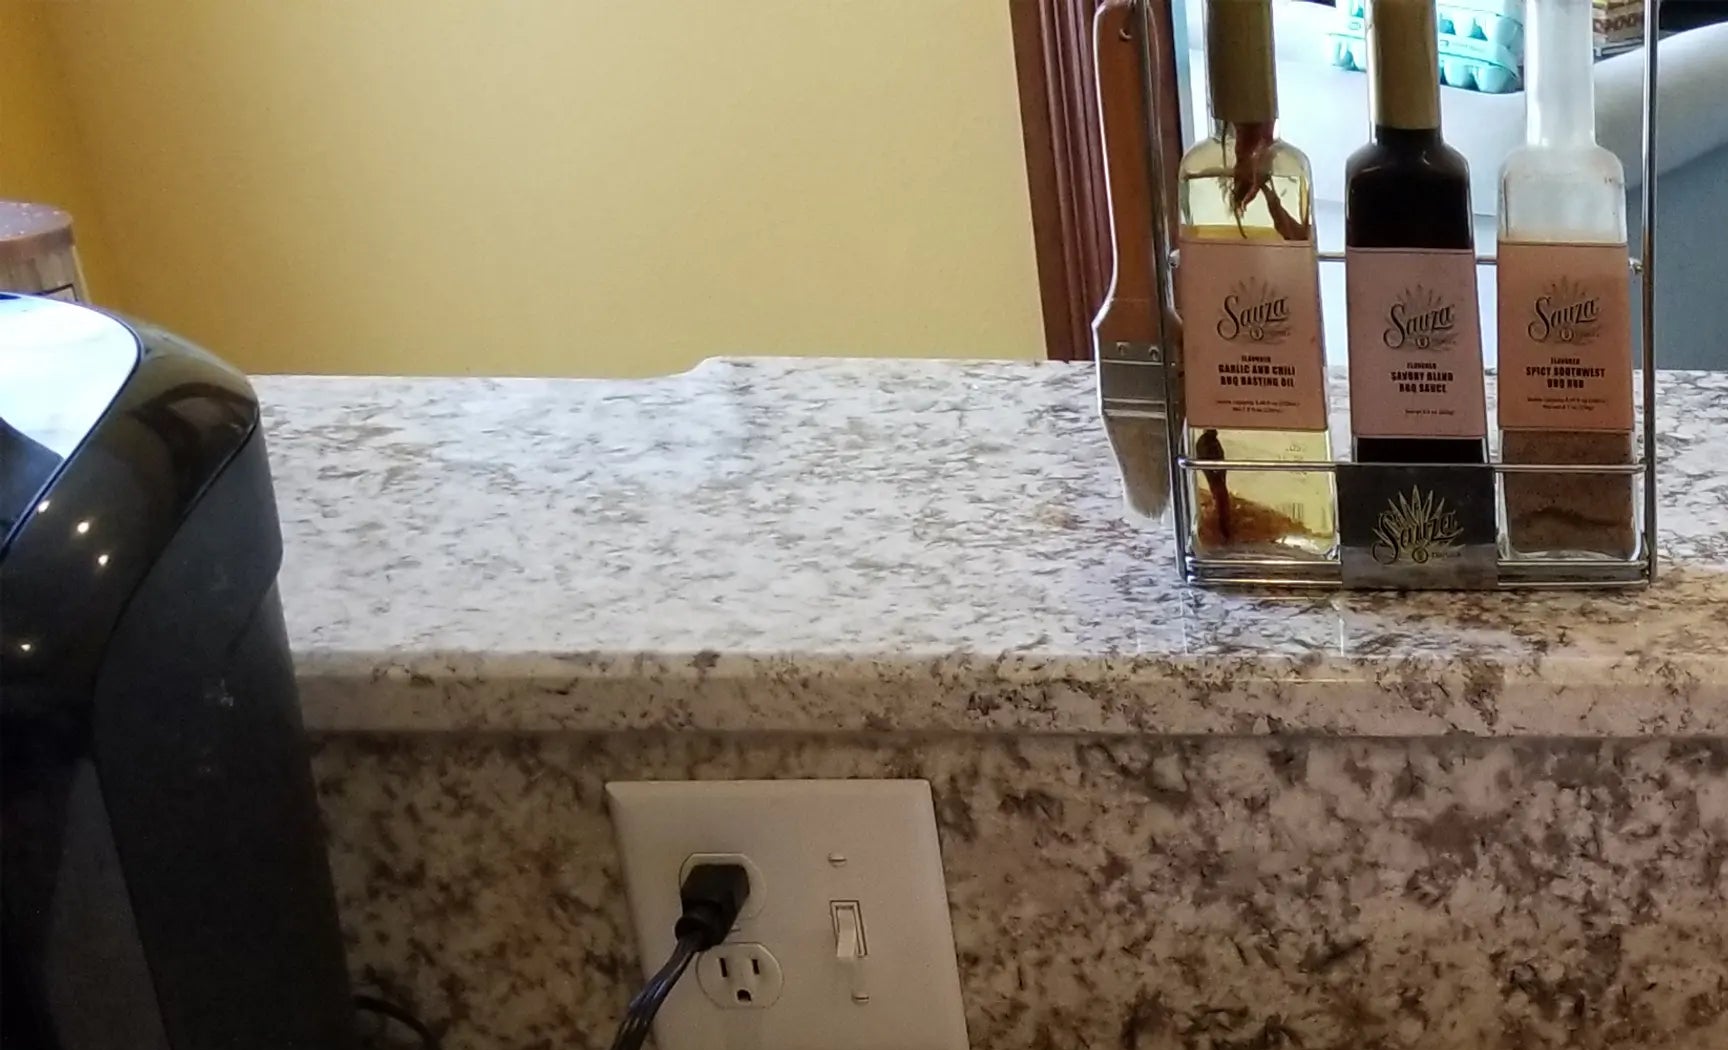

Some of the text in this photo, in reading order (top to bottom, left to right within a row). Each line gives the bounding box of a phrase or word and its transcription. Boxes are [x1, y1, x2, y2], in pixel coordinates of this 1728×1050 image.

[1217, 295, 1289, 340] Sauza
[1528, 296, 1599, 341] Sauza
[1383, 304, 1455, 349] Sauza
[1218, 364, 1296, 376] GARLIC AND CHILI
[1526, 366, 1606, 378] SPICY SOUTHWEST
[1241, 376, 1279, 387] BASTING
[1281, 377, 1295, 388] OIL
[1390, 371, 1424, 382] SAVORY
[1418, 383, 1447, 393] SAUCE
[1372, 510, 1459, 565] Sauza
